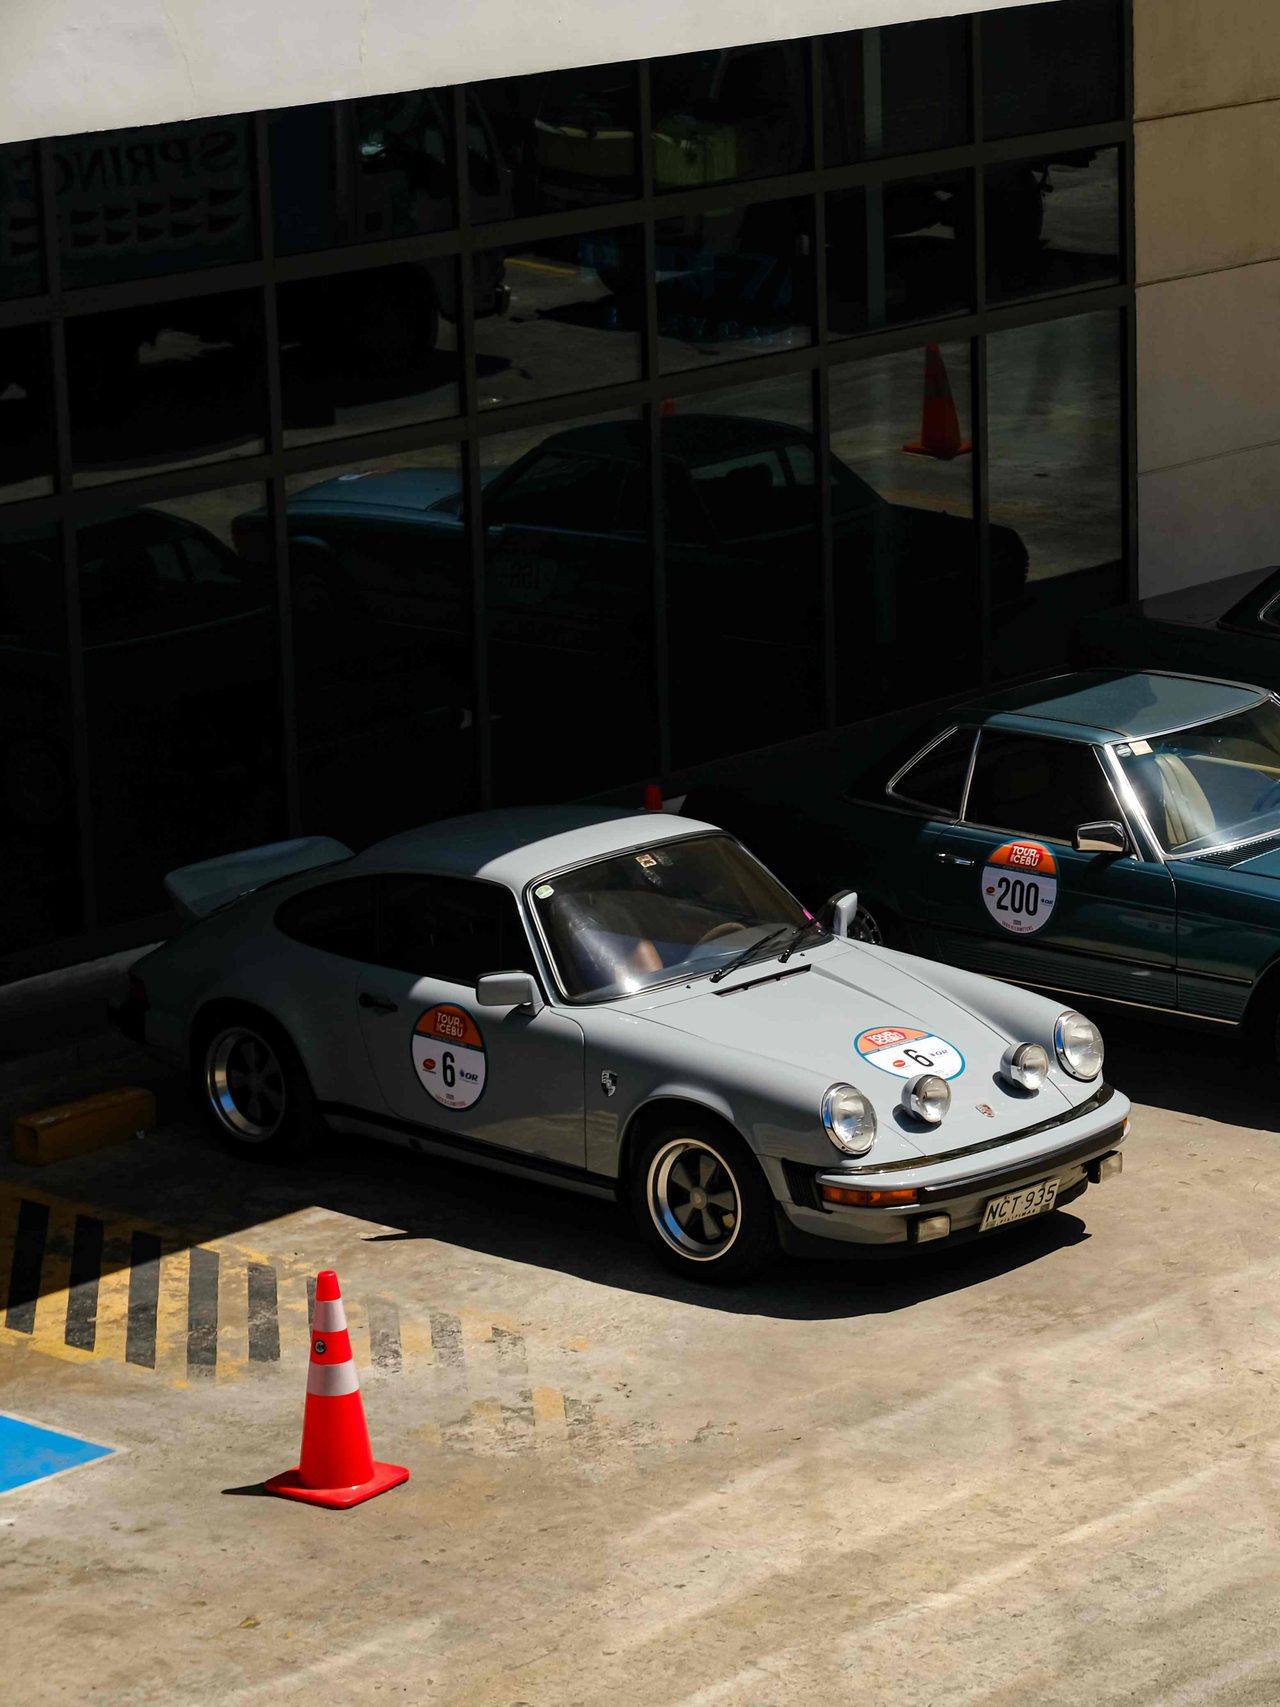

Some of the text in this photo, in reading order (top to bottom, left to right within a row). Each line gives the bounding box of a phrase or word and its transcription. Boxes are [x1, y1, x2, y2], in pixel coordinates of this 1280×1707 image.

[1012, 846, 1038, 857] TOUR
[996, 876, 1040, 917] 200
[436, 1012, 461, 1027] TOUR
[903, 1048, 934, 1067] 6
[442, 1051, 456, 1088] 6
[465, 1071, 479, 1082] OR
[985, 1183, 1058, 1223] NCT 935
